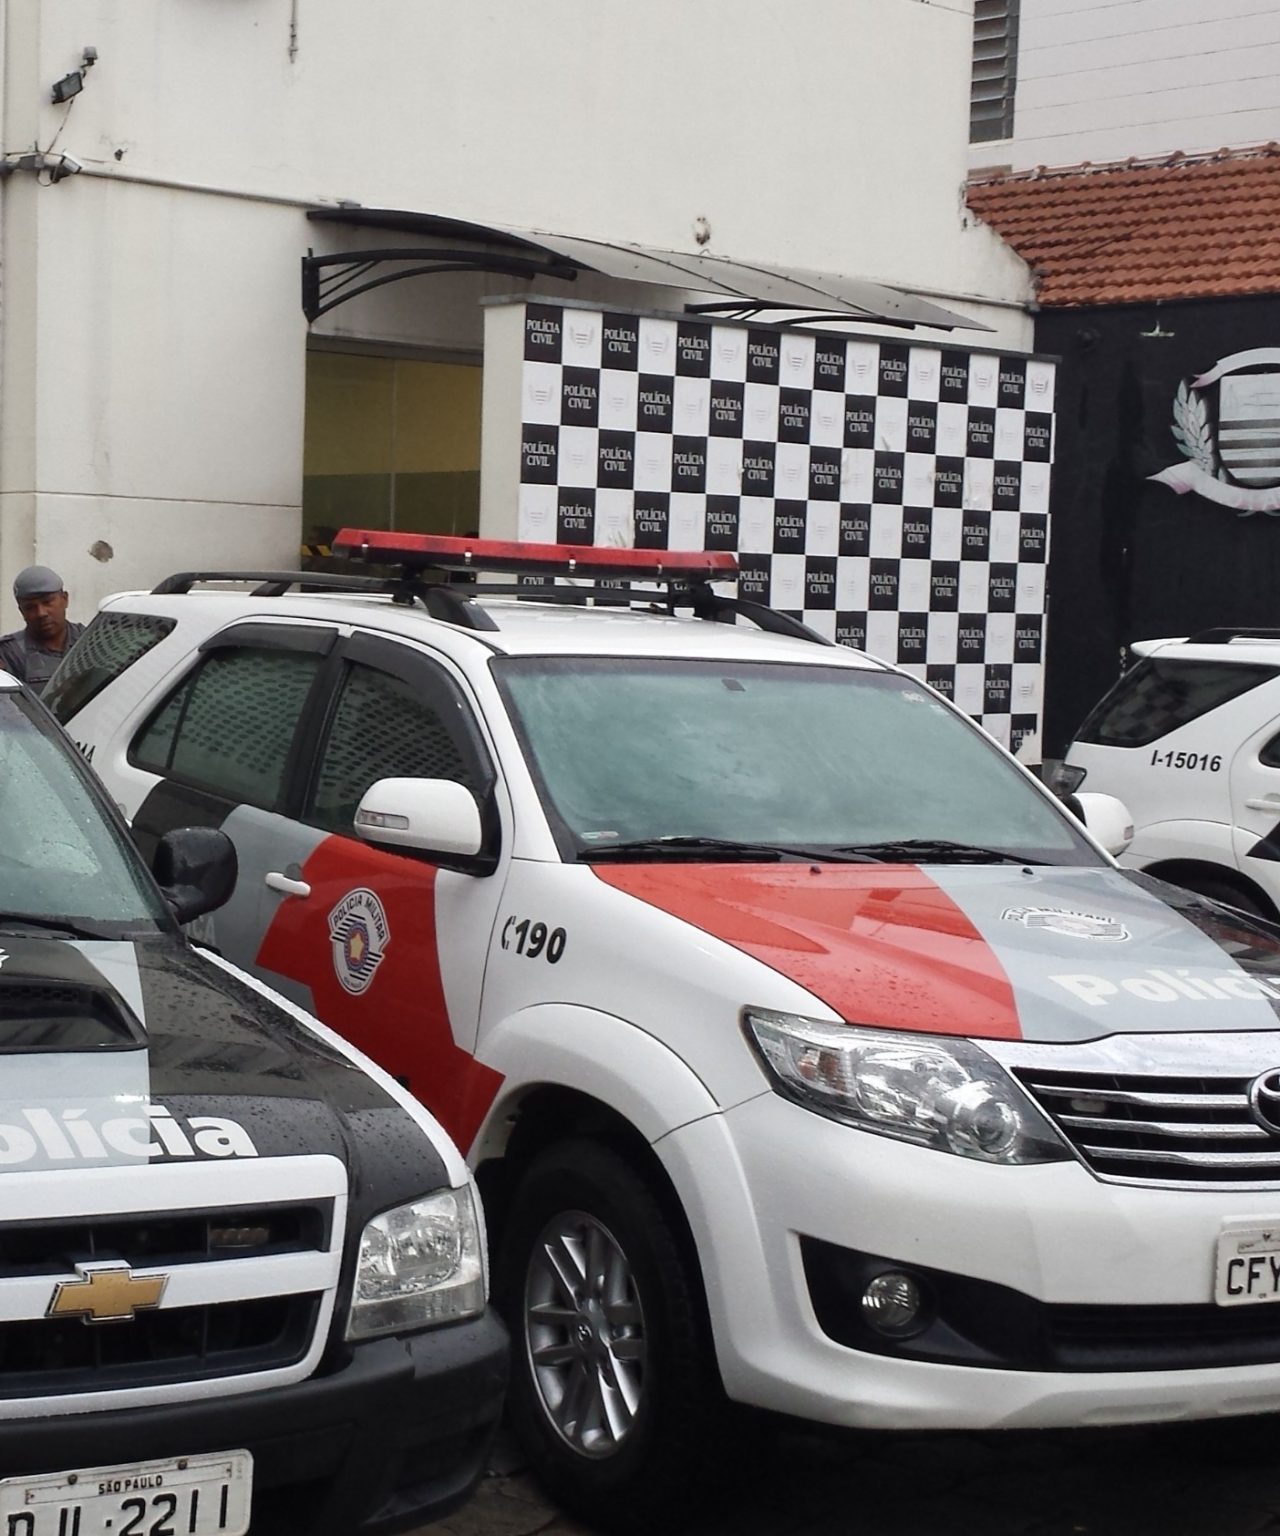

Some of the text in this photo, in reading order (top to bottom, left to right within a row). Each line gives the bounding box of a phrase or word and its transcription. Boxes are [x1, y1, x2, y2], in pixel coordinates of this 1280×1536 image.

[527, 319, 560, 334] POLÍCIA
[530, 332, 555, 345] CIVIL
[603, 327, 636, 342] POLÍCIA
[608, 340, 631, 353] CIVIL
[678, 336, 709, 350] POLÍCIA
[682, 348, 704, 361] CIVIL
[749, 344, 778, 357] POLÍCIA
[752, 356, 773, 368] CIVIL
[816, 352, 844, 365] POLÍCIA
[819, 364, 839, 376] CIVIL
[880, 359, 907, 372] POLÍCIA
[883, 370, 903, 382] CIVIL
[942, 366, 967, 378] POLÍCIA
[944, 377, 962, 388] CIVIL
[1000, 373, 1024, 384] POLÍCIA
[563, 384, 597, 398] POLÍCIA
[1002, 383, 1020, 394] CIVIL
[567, 397, 591, 409] CIVIL
[639, 391, 672, 406] POLÍCIA
[711, 397, 742, 410] POLÍCIA
[643, 404, 666, 416] CIVIL
[715, 409, 736, 421] CIVIL
[780, 404, 809, 417] POLÍCIA
[783, 416, 804, 427] CIVIL
[846, 411, 874, 424] POLÍCIA
[909, 416, 935, 429] POLÍCIA
[849, 422, 869, 433] CIVIL
[911, 427, 930, 438] CIVIL
[968, 422, 993, 433] POLÍCIA
[1025, 427, 1049, 438] POLÍCIA
[971, 432, 989, 443] CIVIL
[1028, 437, 1045, 448] CIVIL
[522, 441, 556, 455] POLÍCIA
[526, 454, 550, 467] CIVIL
[599, 447, 632, 462] POLÍCIA
[674, 452, 705, 466] POLÍCIA
[603, 460, 627, 471] CIVIL
[744, 457, 773, 470] POLÍCIA
[811, 462, 839, 475] POLÍCIA
[677, 465, 700, 477] CIVIL
[747, 469, 768, 480] CIVIL
[875, 467, 902, 479] POLÍCIA
[936, 471, 962, 483] POLÍCIA
[814, 474, 834, 485] CIVIL
[878, 478, 897, 489] CIVIL
[995, 476, 1019, 486] POLÍCIA
[939, 482, 957, 493] CIVIL
[997, 486, 1015, 496] CIVIL
[559, 504, 592, 517] POLÍCIA
[636, 508, 667, 521] POLÍCIA
[563, 517, 587, 529] CIVIL
[707, 511, 737, 523] POLÍCIA
[775, 515, 804, 527] POLÍCIA
[639, 521, 662, 532] CIVIL
[710, 523, 732, 535] CIVIL
[841, 519, 869, 531] POLÍCIA
[904, 522, 930, 534] POLÍCIA
[963, 526, 988, 536] POLÍCIA
[779, 527, 799, 538] CIVIL
[844, 530, 864, 541] CIVIL
[906, 533, 925, 543] CIVIL
[1021, 528, 1045, 540] POLÍCIA
[966, 536, 984, 546] CIVIL
[1023, 539, 1040, 548] CIVIL
[740, 569, 769, 581] POLÍCIA
[807, 572, 835, 584] POLÍCIA
[871, 574, 897, 585] POLÍCIA
[932, 576, 957, 586] POLÍCIA
[743, 581, 764, 592] CIVIL
[809, 583, 830, 594] CIVIL
[990, 578, 1014, 588] POLÍCIA
[874, 585, 893, 595] CIVIL
[935, 587, 953, 597] CIVIL
[992, 588, 1010, 598] CIVIL
[838, 626, 865, 638] POLÍCIA
[900, 627, 926, 640] POLÍCIA
[959, 628, 984, 639] POLÍCIA
[1016, 629, 1040, 639] POLÍCIA
[902, 638, 921, 648] CIVIL
[961, 639, 979, 648] CIVIL
[1018, 639, 1035, 648] CIVIL
[986, 679, 1009, 689] POLÍCIA
[988, 689, 1005, 699] CIVIL
[1151, 750, 1222, 773] I-15016
[515, 918, 567, 965] 190
[98, 1474, 164, 1495] SÃO PAULO
